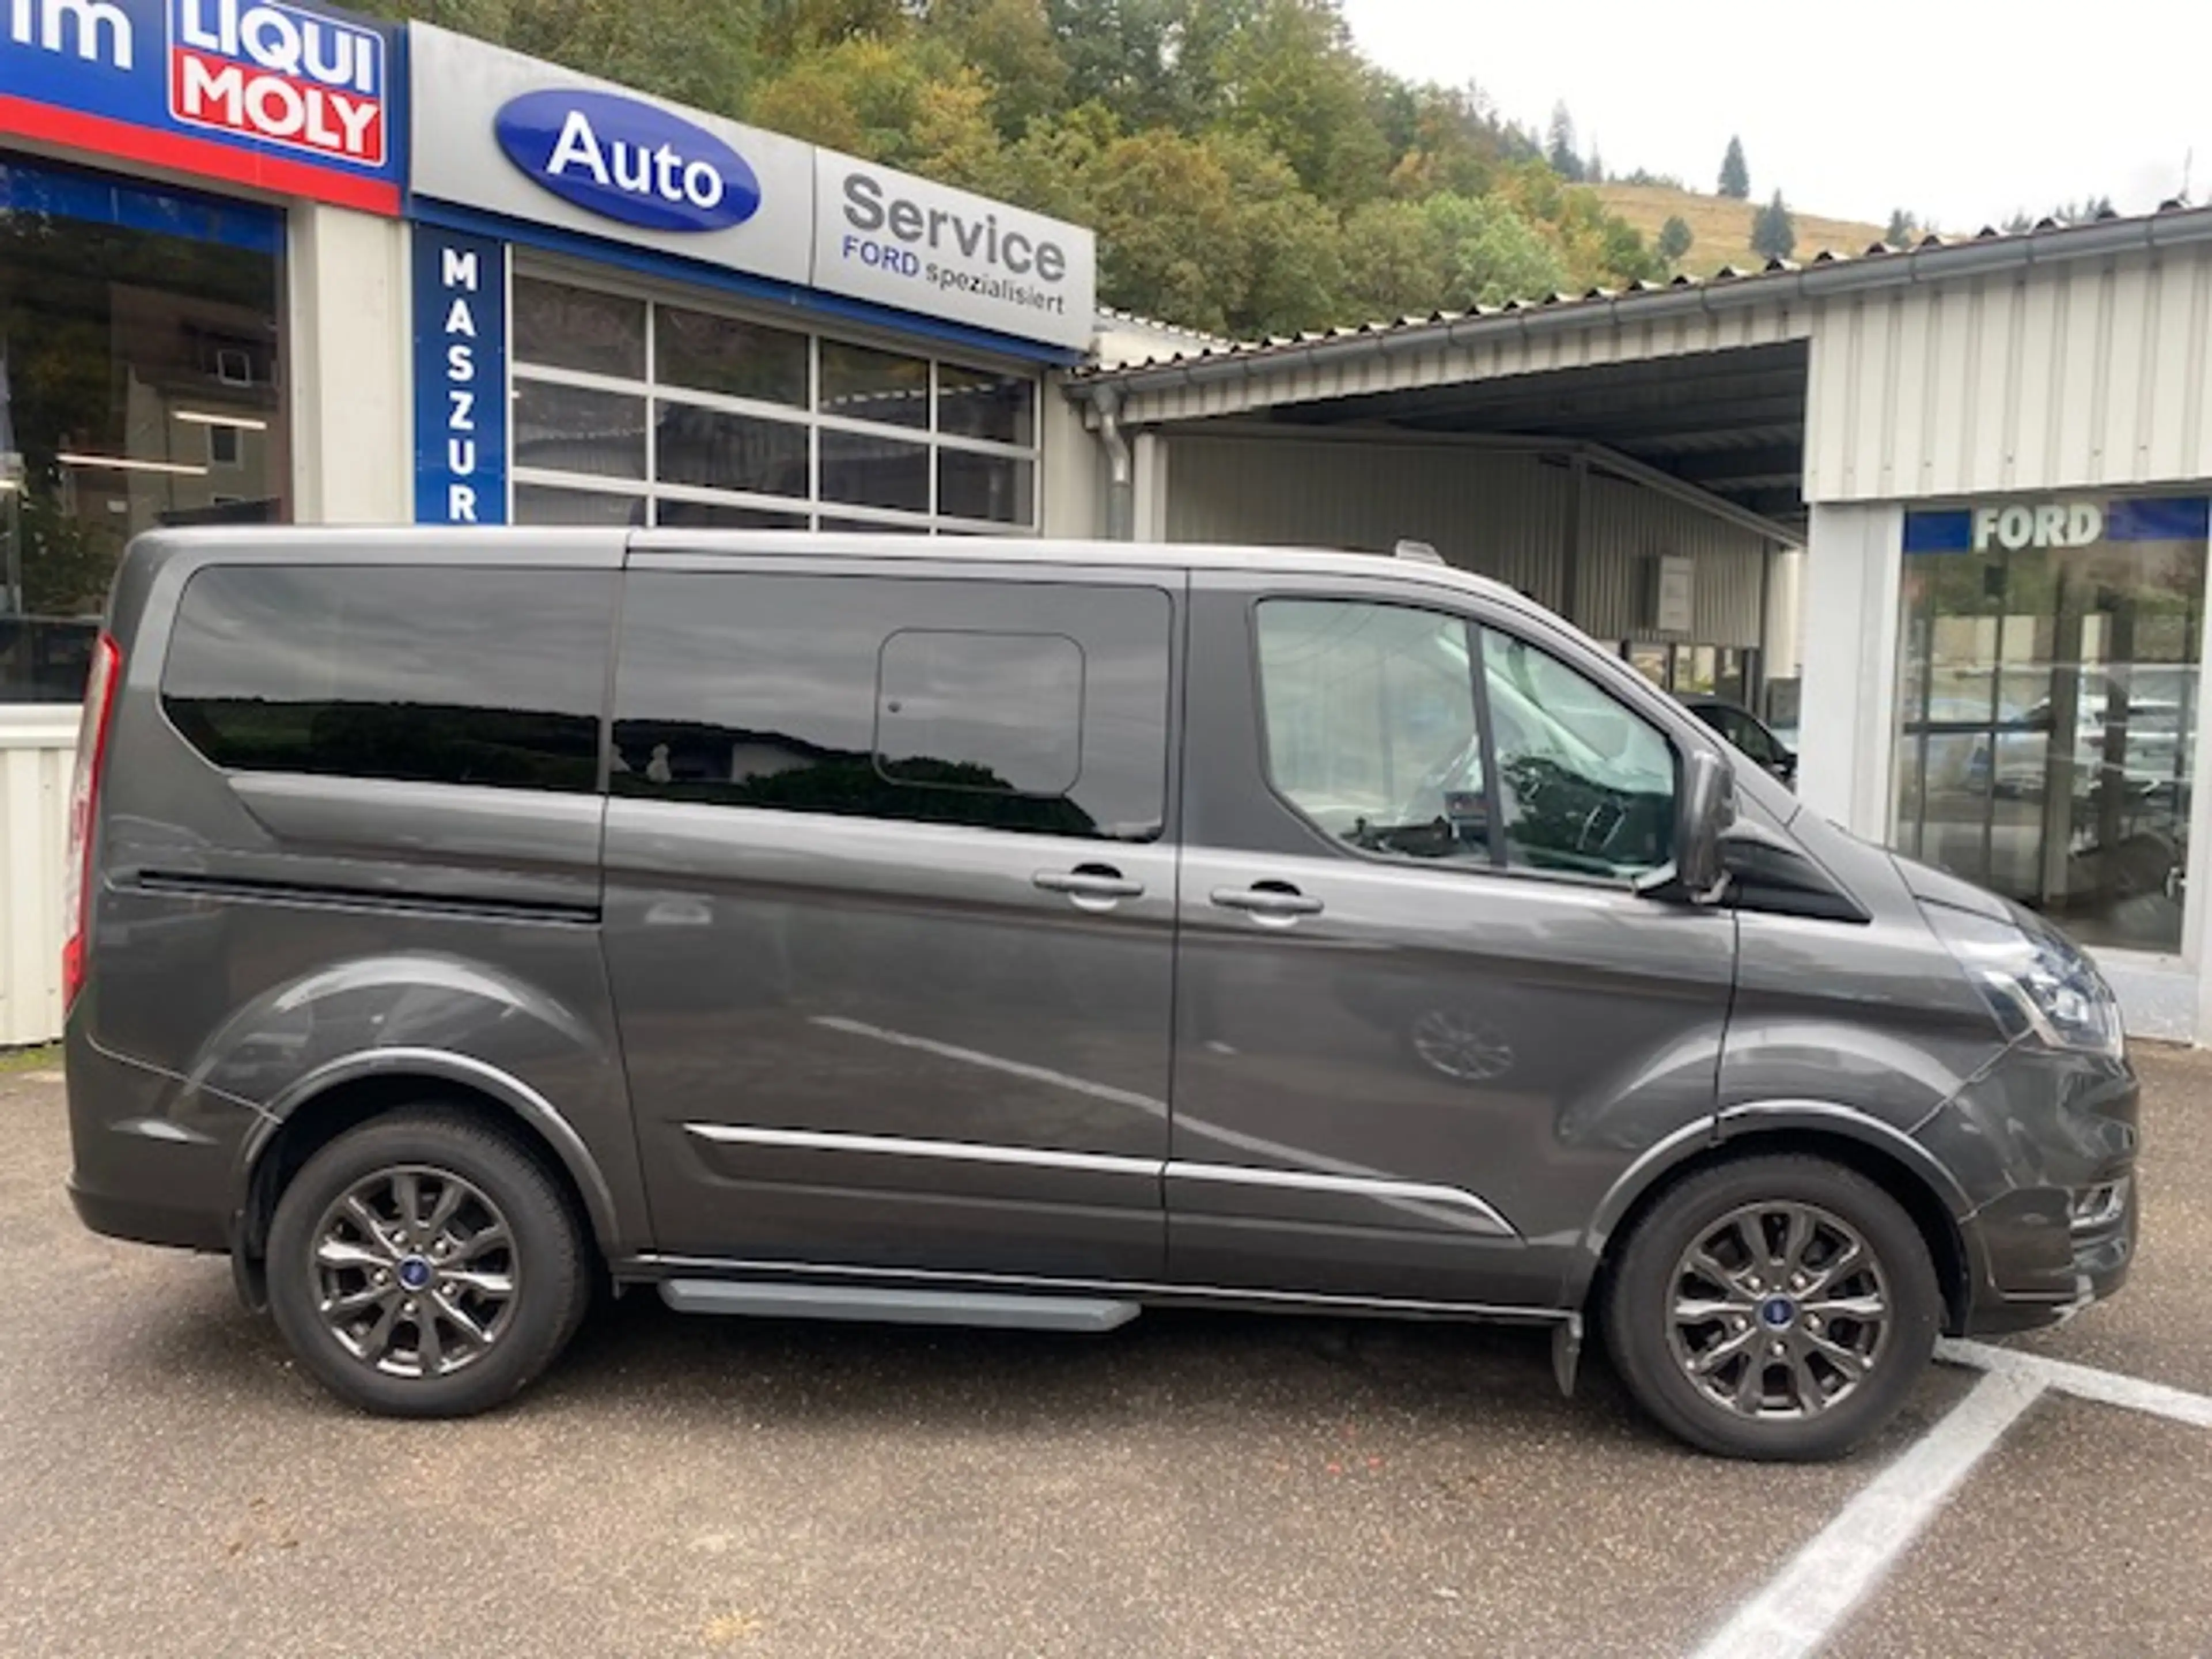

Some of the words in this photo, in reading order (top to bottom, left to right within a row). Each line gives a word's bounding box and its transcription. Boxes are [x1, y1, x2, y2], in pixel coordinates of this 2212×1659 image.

[183, 0, 372, 93] LIQUI
[183, 56, 378, 153] MOLY
[547, 109, 723, 210] Auto
[842, 235, 920, 278] FORD
[926, 263, 1065, 315] spezialisiert
[843, 173, 1065, 282] Service
[442, 248, 478, 521] MASZUR
[1974, 503, 2101, 553] FORD
